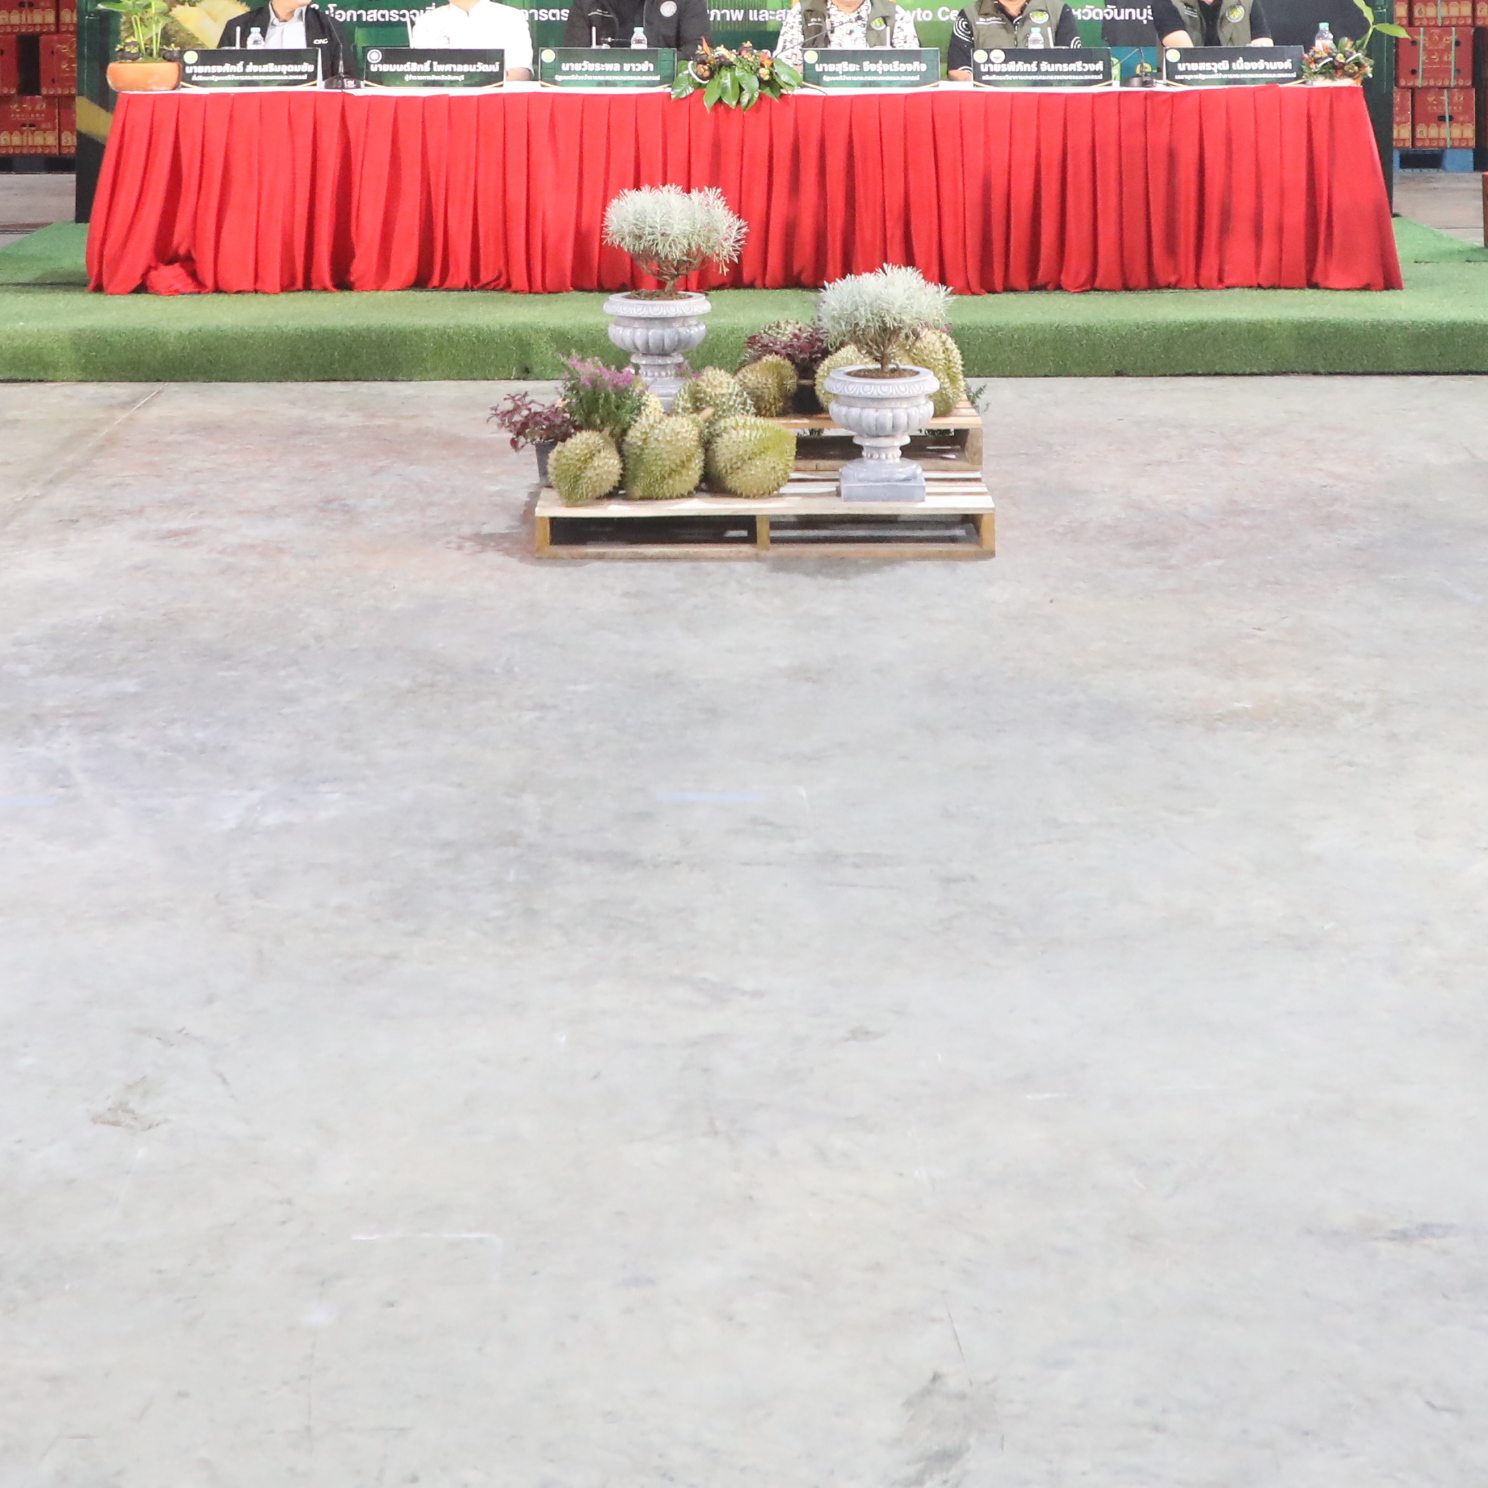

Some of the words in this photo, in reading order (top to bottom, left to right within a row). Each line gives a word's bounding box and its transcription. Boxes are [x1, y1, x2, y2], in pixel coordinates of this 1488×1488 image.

[937, 6, 960, 22] Ce
[561, 60, 621, 72] นายวัชระพล
[623, 60, 654, 72] ขาวขำ
[815, 61, 861, 74] นายสุริยะ
[862, 59, 928, 74] จึงรุ่งเรืองกิจ
